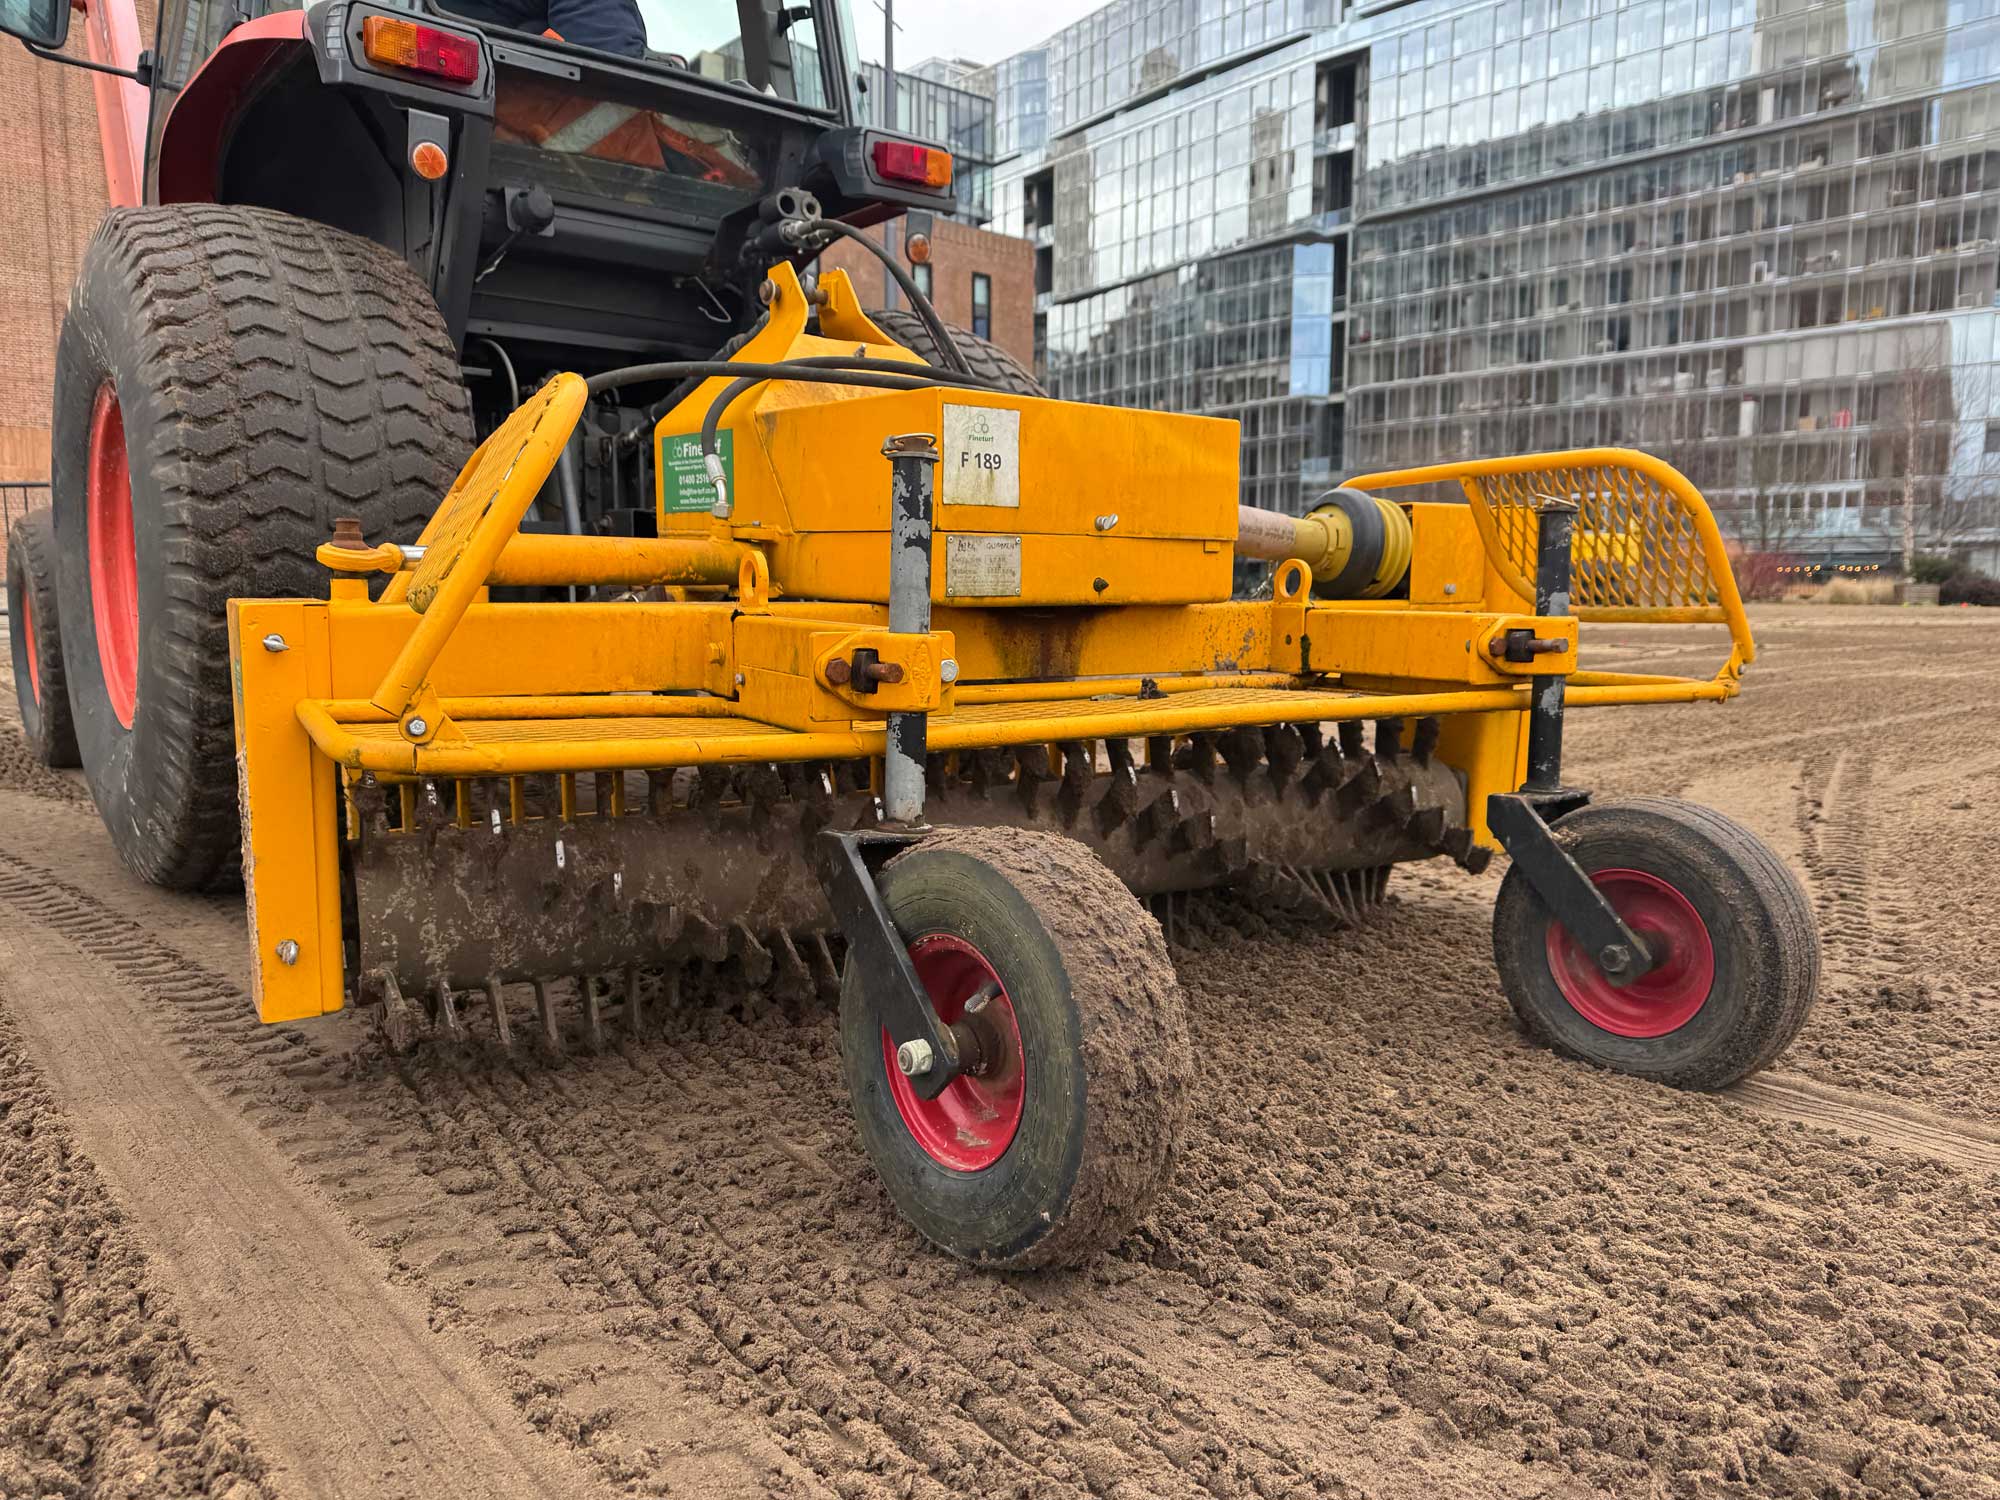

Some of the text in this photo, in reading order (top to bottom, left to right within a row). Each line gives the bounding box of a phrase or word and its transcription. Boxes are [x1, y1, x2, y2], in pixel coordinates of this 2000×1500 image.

[683, 438, 721, 458] Finef
[968, 434, 994, 443] Fineturf
[961, 451, 1002, 470] F 189
